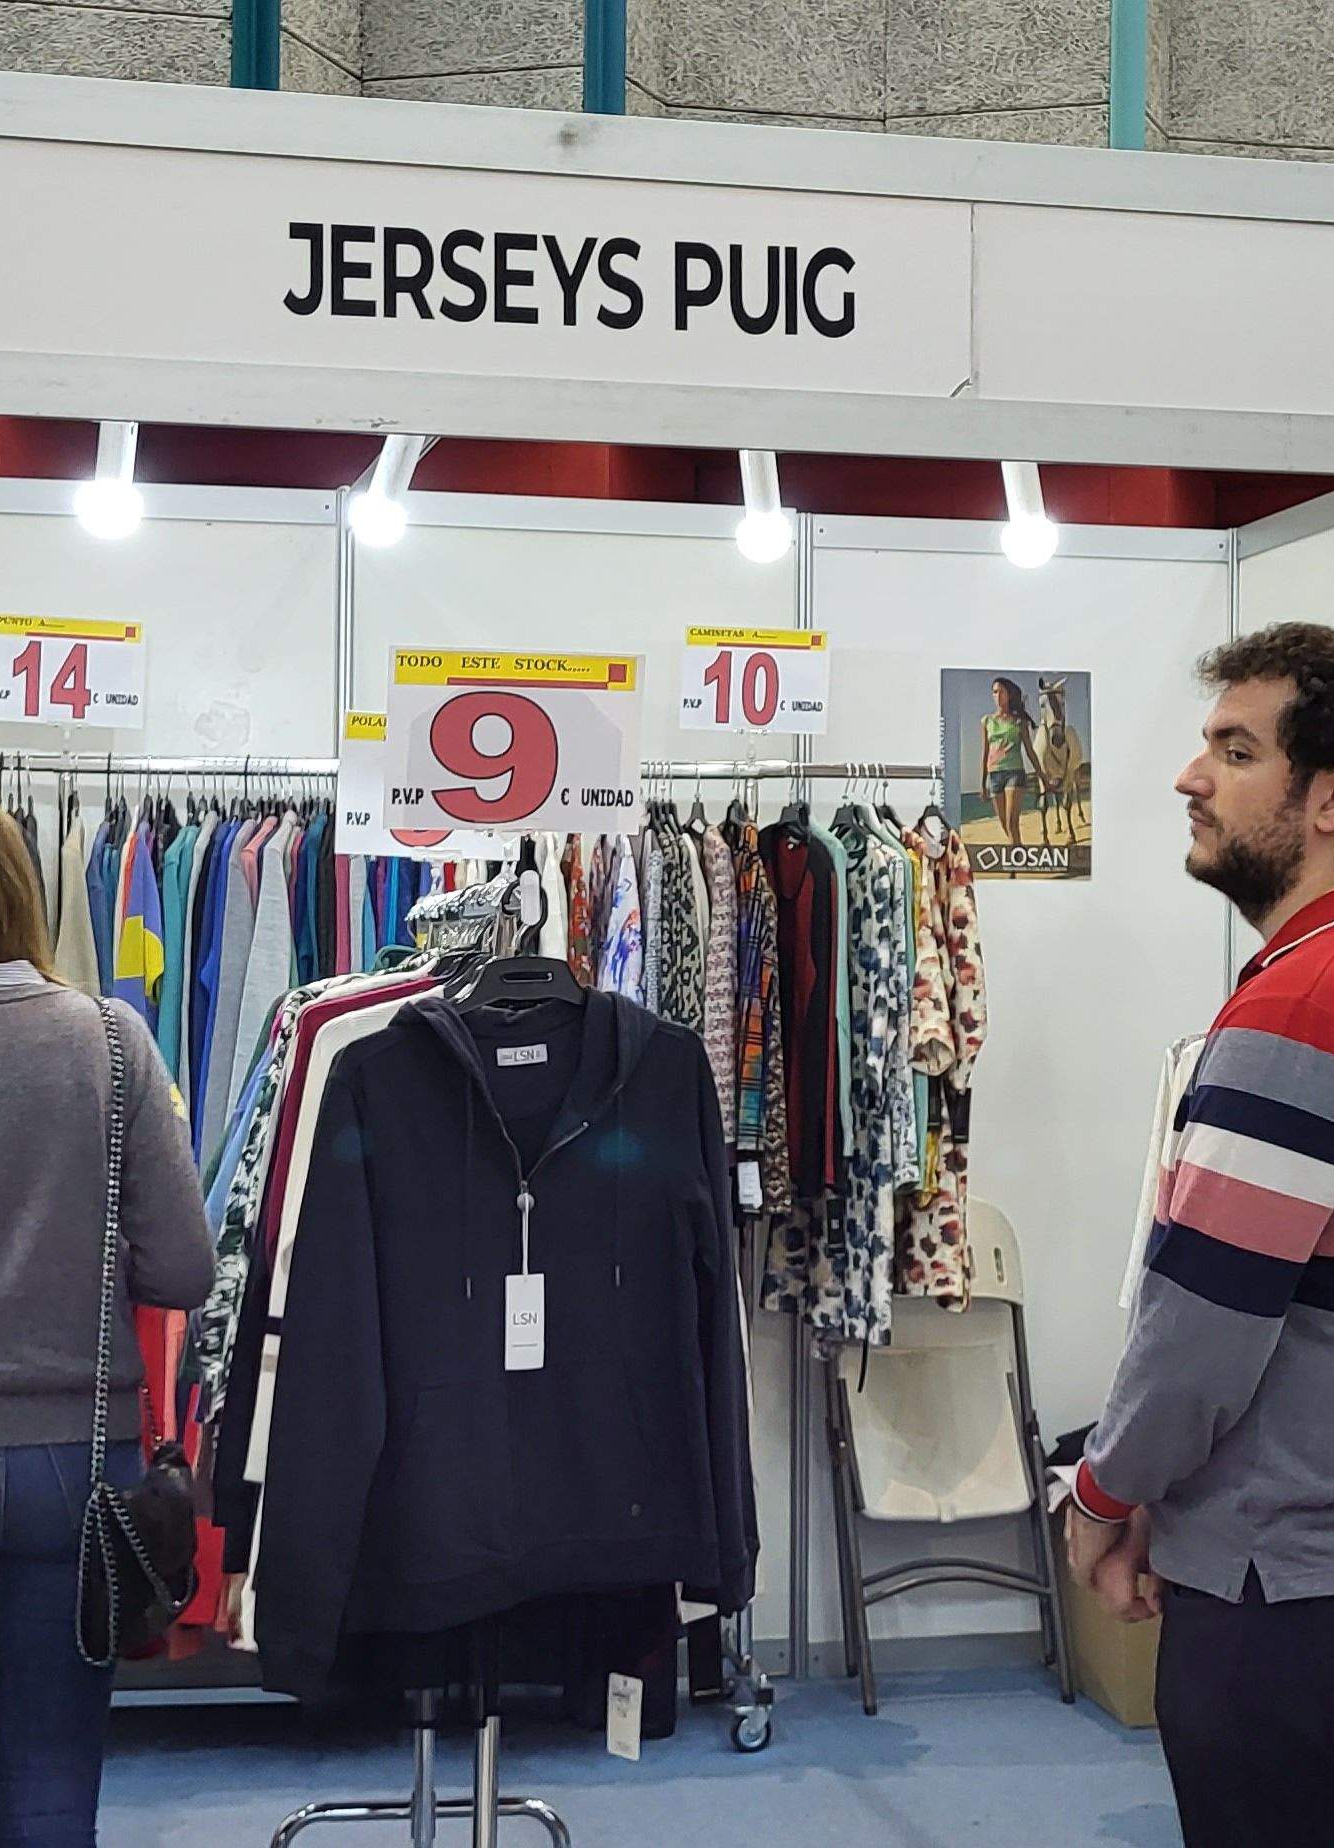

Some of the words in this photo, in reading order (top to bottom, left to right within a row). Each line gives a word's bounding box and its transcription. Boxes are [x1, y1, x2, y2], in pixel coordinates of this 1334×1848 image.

[283, 221, 643, 330] JERSEYS
[674, 242, 856, 338] PUIG
[690, 627, 744, 638] CAMISETAS
[396, 654, 443, 668] TODO
[461, 657, 501, 670] ESTE
[13, 641, 91, 719] 14
[106, 693, 138, 706] UNIDAD
[683, 698, 702, 709] P.V.P
[704, 650, 779, 726] 10
[792, 701, 823, 712] UNIDAD
[351, 715, 387, 727] POLA
[392, 787, 424, 805] P.V.P
[430, 691, 558, 823] 9
[581, 787, 634, 807] UNIDAD
[347, 811, 370, 826] P.V.P
[1001, 846, 1068, 866] LOSAN
[513, 1049, 535, 1062] LSN
[512, 1312, 538, 1325] LSN
